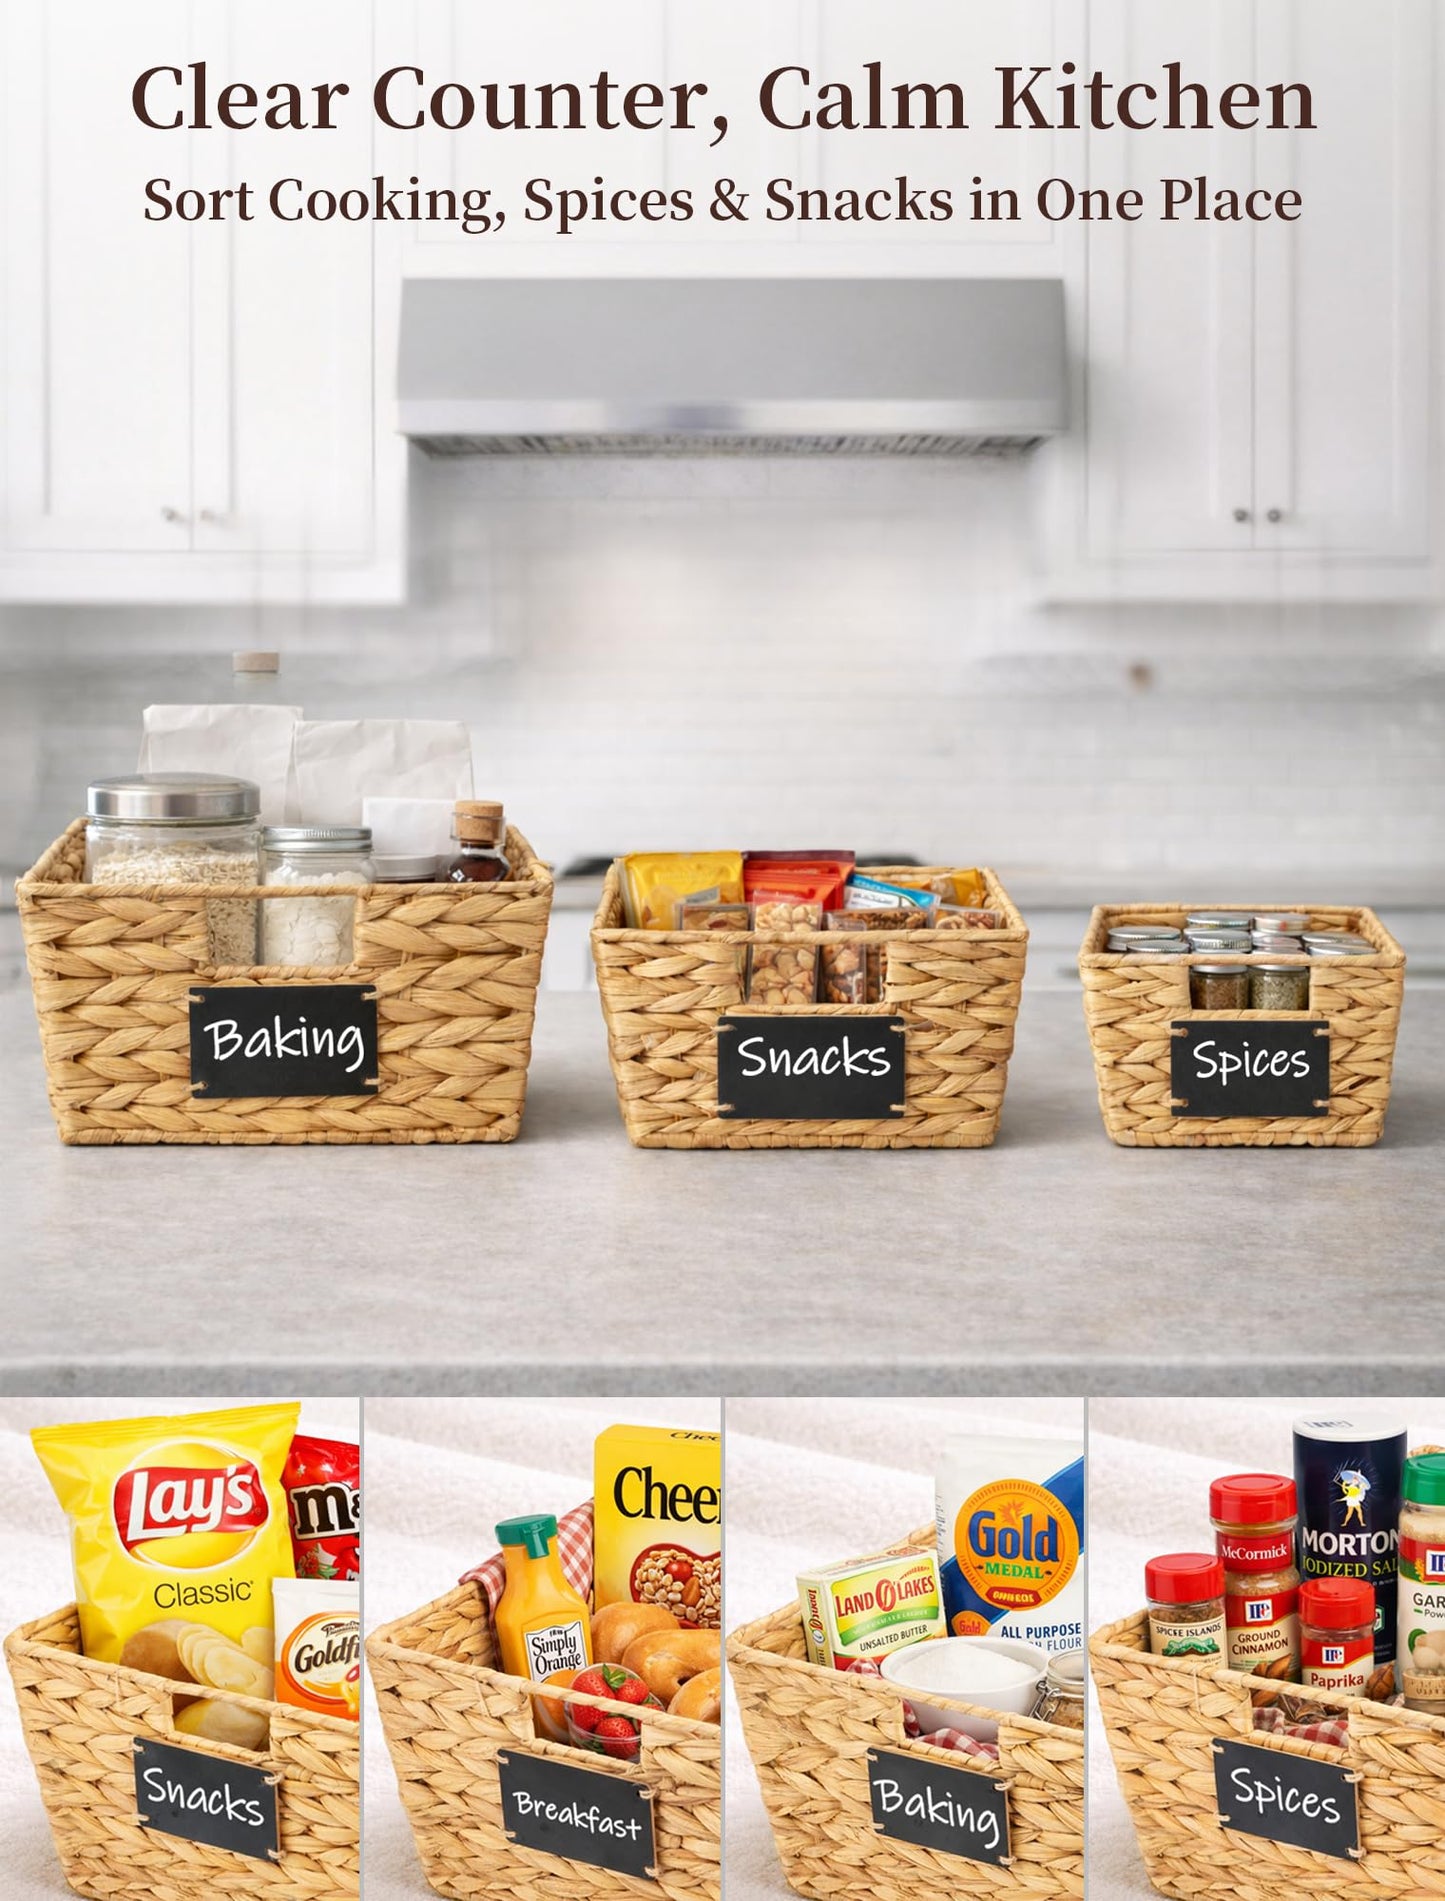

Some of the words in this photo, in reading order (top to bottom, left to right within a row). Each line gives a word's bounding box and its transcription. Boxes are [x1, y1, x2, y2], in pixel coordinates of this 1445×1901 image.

[203, 1015, 365, 1073] Baking
[737, 1035, 891, 1077] Snacks
[1194, 1040, 1311, 1086] Spices
[127, 1464, 254, 1542] Lay's
[968, 1510, 1060, 1563] Gold
[1221, 1543, 1288, 1561] McCormick
[985, 1561, 1045, 1580] MEDAL
[1302, 1555, 1368, 1578] IODIZED
[153, 1578, 253, 1609] Classic
[835, 1592, 875, 1618] LAND
[859, 1632, 900, 1652] UNSALTED
[900, 1623, 928, 1640] BUTTER
[1001, 1625, 1022, 1639] ALL
[1026, 1622, 1082, 1639] PURPOSE
[1185, 1622, 1222, 1637] ISLANDS
[1237, 1629, 1281, 1644] GROUND
[531, 1630, 577, 1657] Simply
[1047, 1636, 1083, 1652] FLOUR
[1232, 1637, 1289, 1656] CINNAMON
[535, 1652, 582, 1675] Orange
[1310, 1672, 1365, 1691] Paprika
[143, 1767, 265, 1826] Snacks
[1230, 1767, 1341, 1824] Spices
[512, 1791, 642, 1841] Breakfast
[872, 1779, 1000, 1850] Baking
